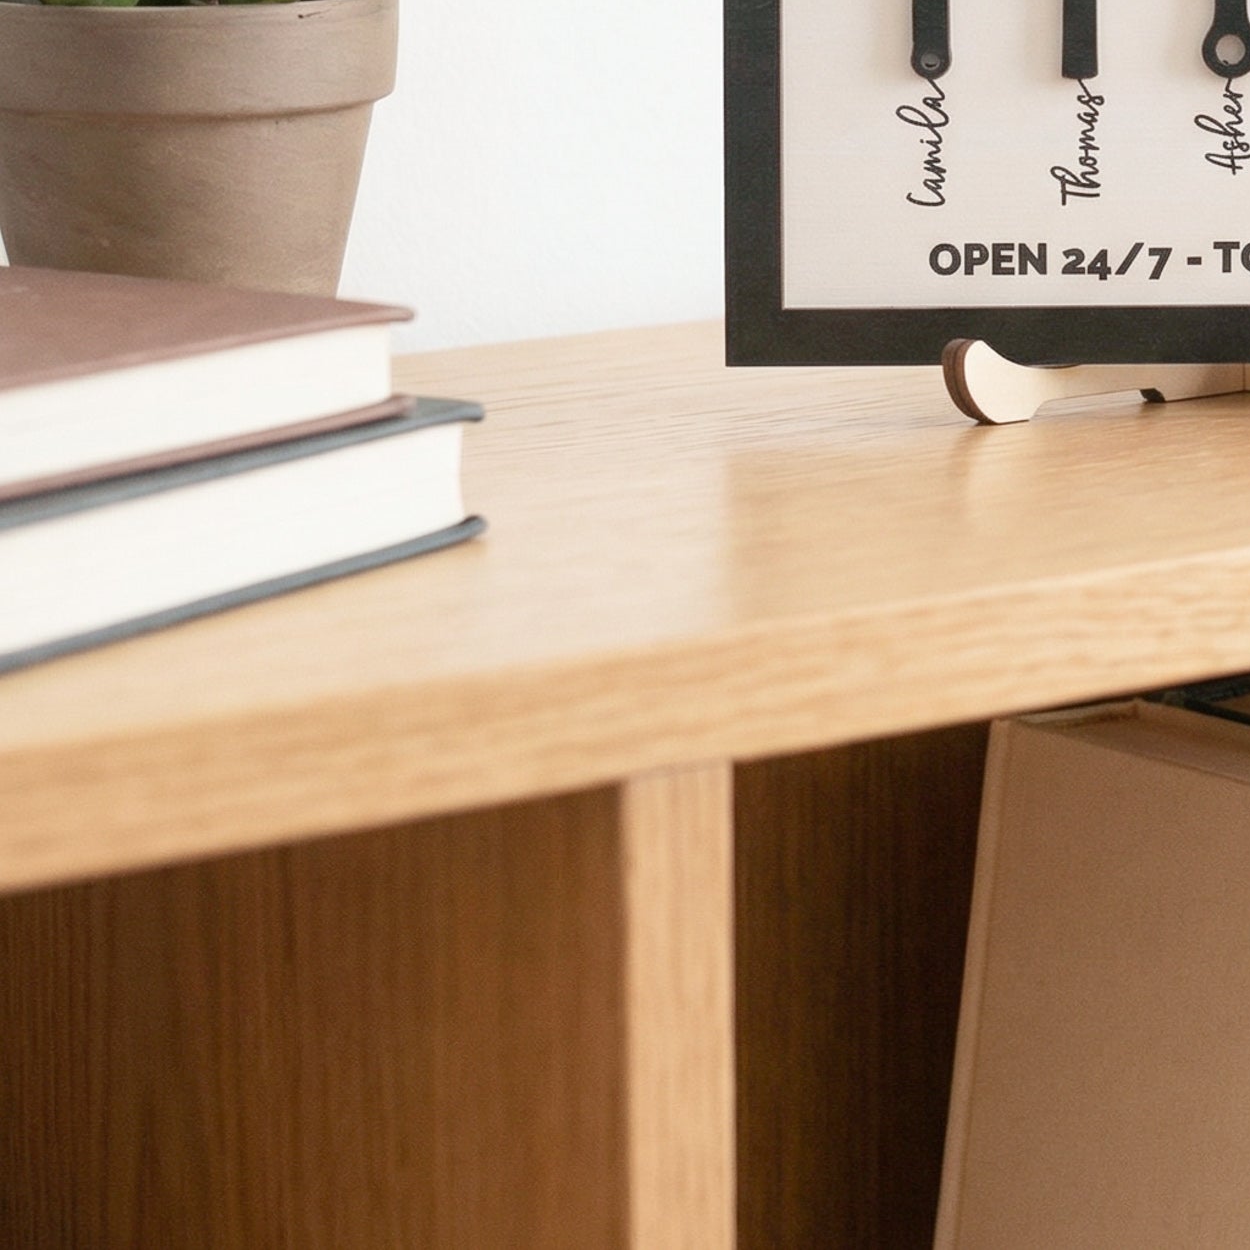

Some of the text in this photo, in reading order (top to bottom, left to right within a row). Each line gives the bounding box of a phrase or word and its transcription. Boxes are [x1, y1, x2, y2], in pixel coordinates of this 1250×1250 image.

[895, 78, 949, 207] Camila
[1050, 78, 1105, 206] Thomas
[929, 243, 1047, 276] OPEN
[1061, 243, 1173, 281] 24/7
